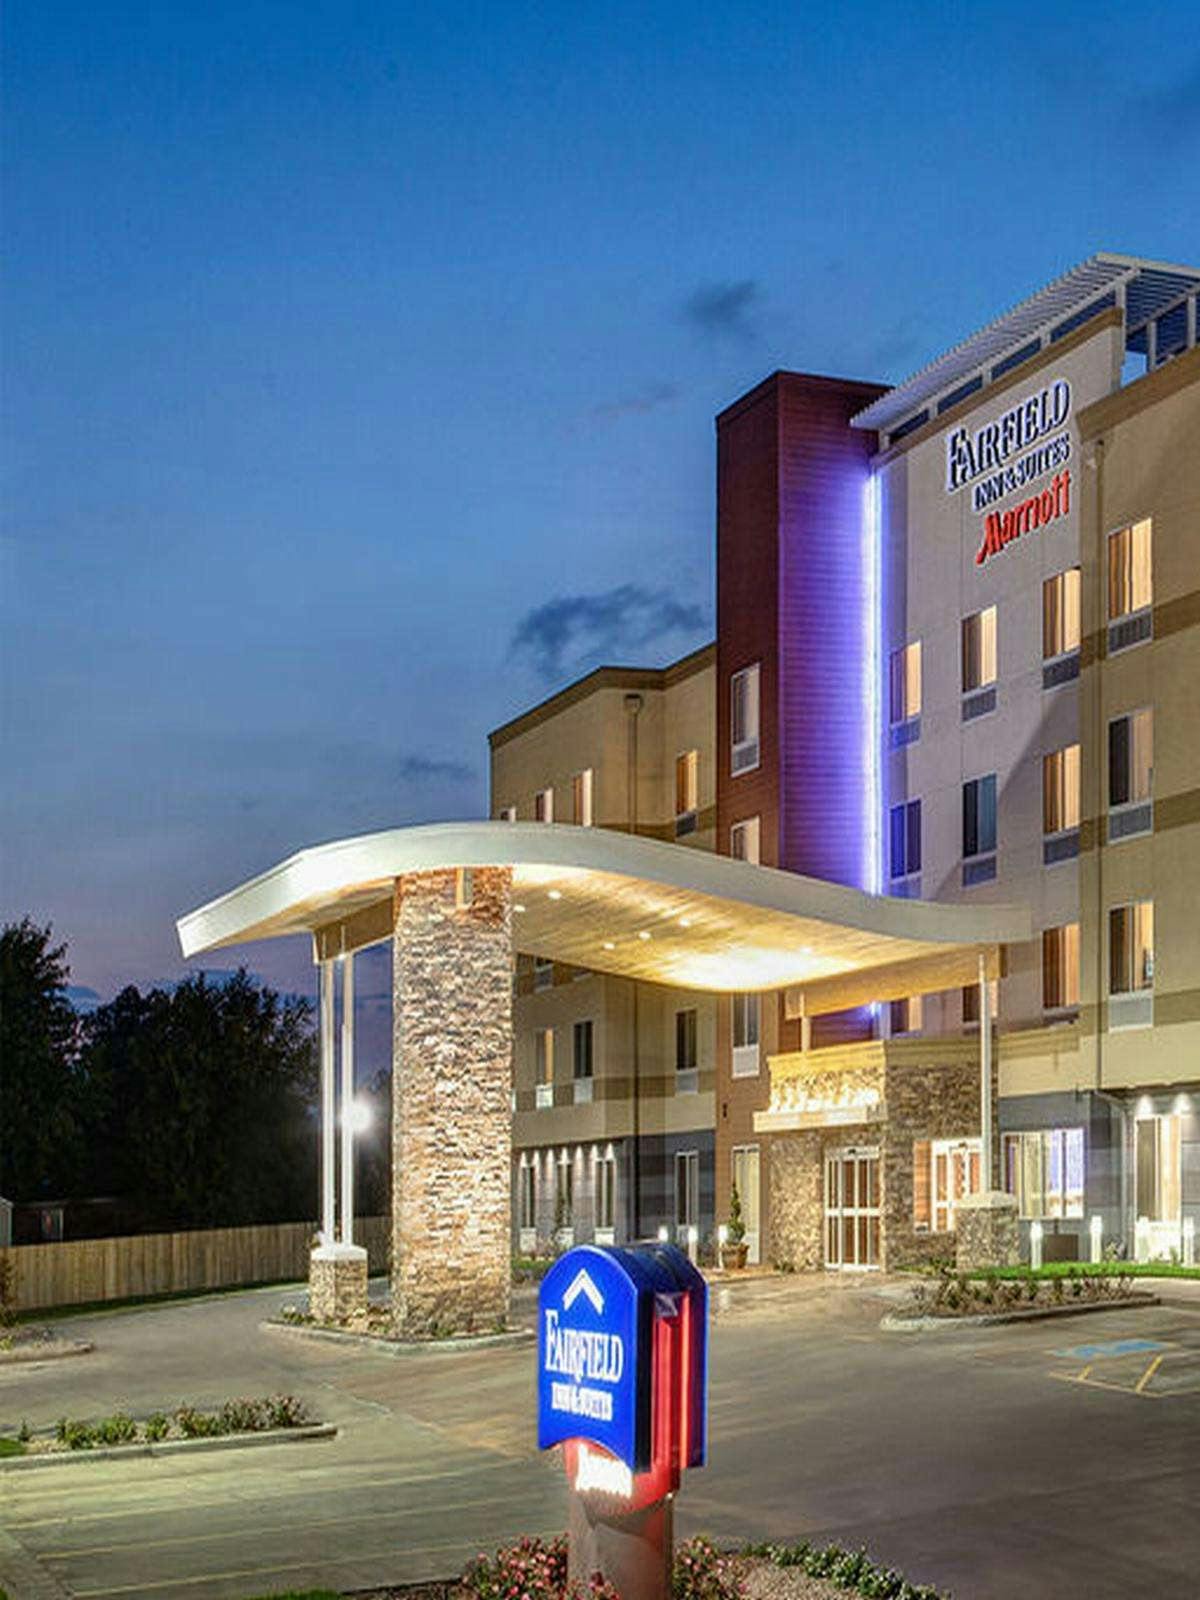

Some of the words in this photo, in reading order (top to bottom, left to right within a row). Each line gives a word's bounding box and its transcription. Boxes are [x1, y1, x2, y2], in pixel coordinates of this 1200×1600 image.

[947, 379, 1071, 493] FAIRFIELD
[976, 469, 1071, 565] Marriott
[545, 1309, 624, 1384] FAIRFIELD
